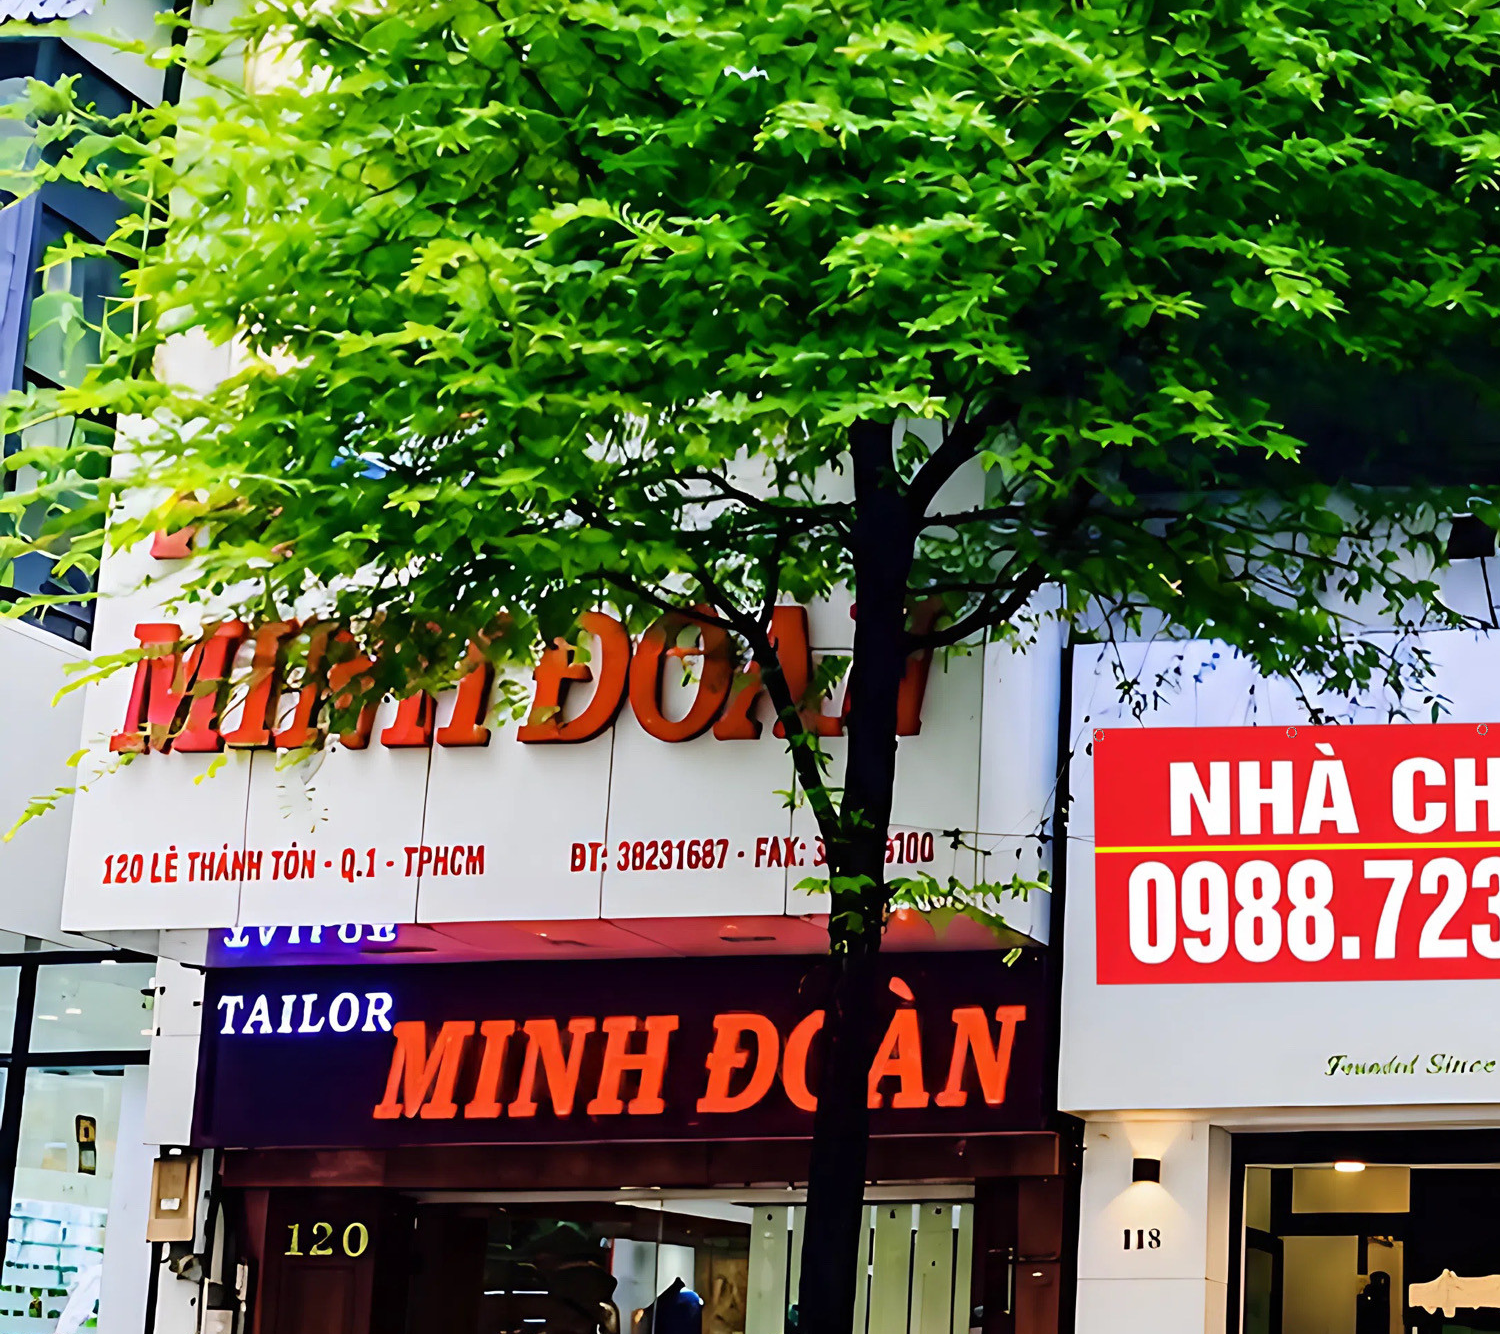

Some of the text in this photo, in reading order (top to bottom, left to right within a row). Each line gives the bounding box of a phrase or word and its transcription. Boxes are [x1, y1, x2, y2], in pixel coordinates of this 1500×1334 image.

[1169, 742, 1360, 837] NHÀ
[101, 853, 144, 884] 120
[341, 847, 377, 883] Q.1
[403, 844, 485, 878] TPHCM
[754, 836, 807, 868] FAX:
[217, 992, 393, 1035] TAILOR
[373, 1014, 679, 1119] MINH
[284, 1222, 370, 1258] 120
[1123, 1228, 1161, 1250] 118
